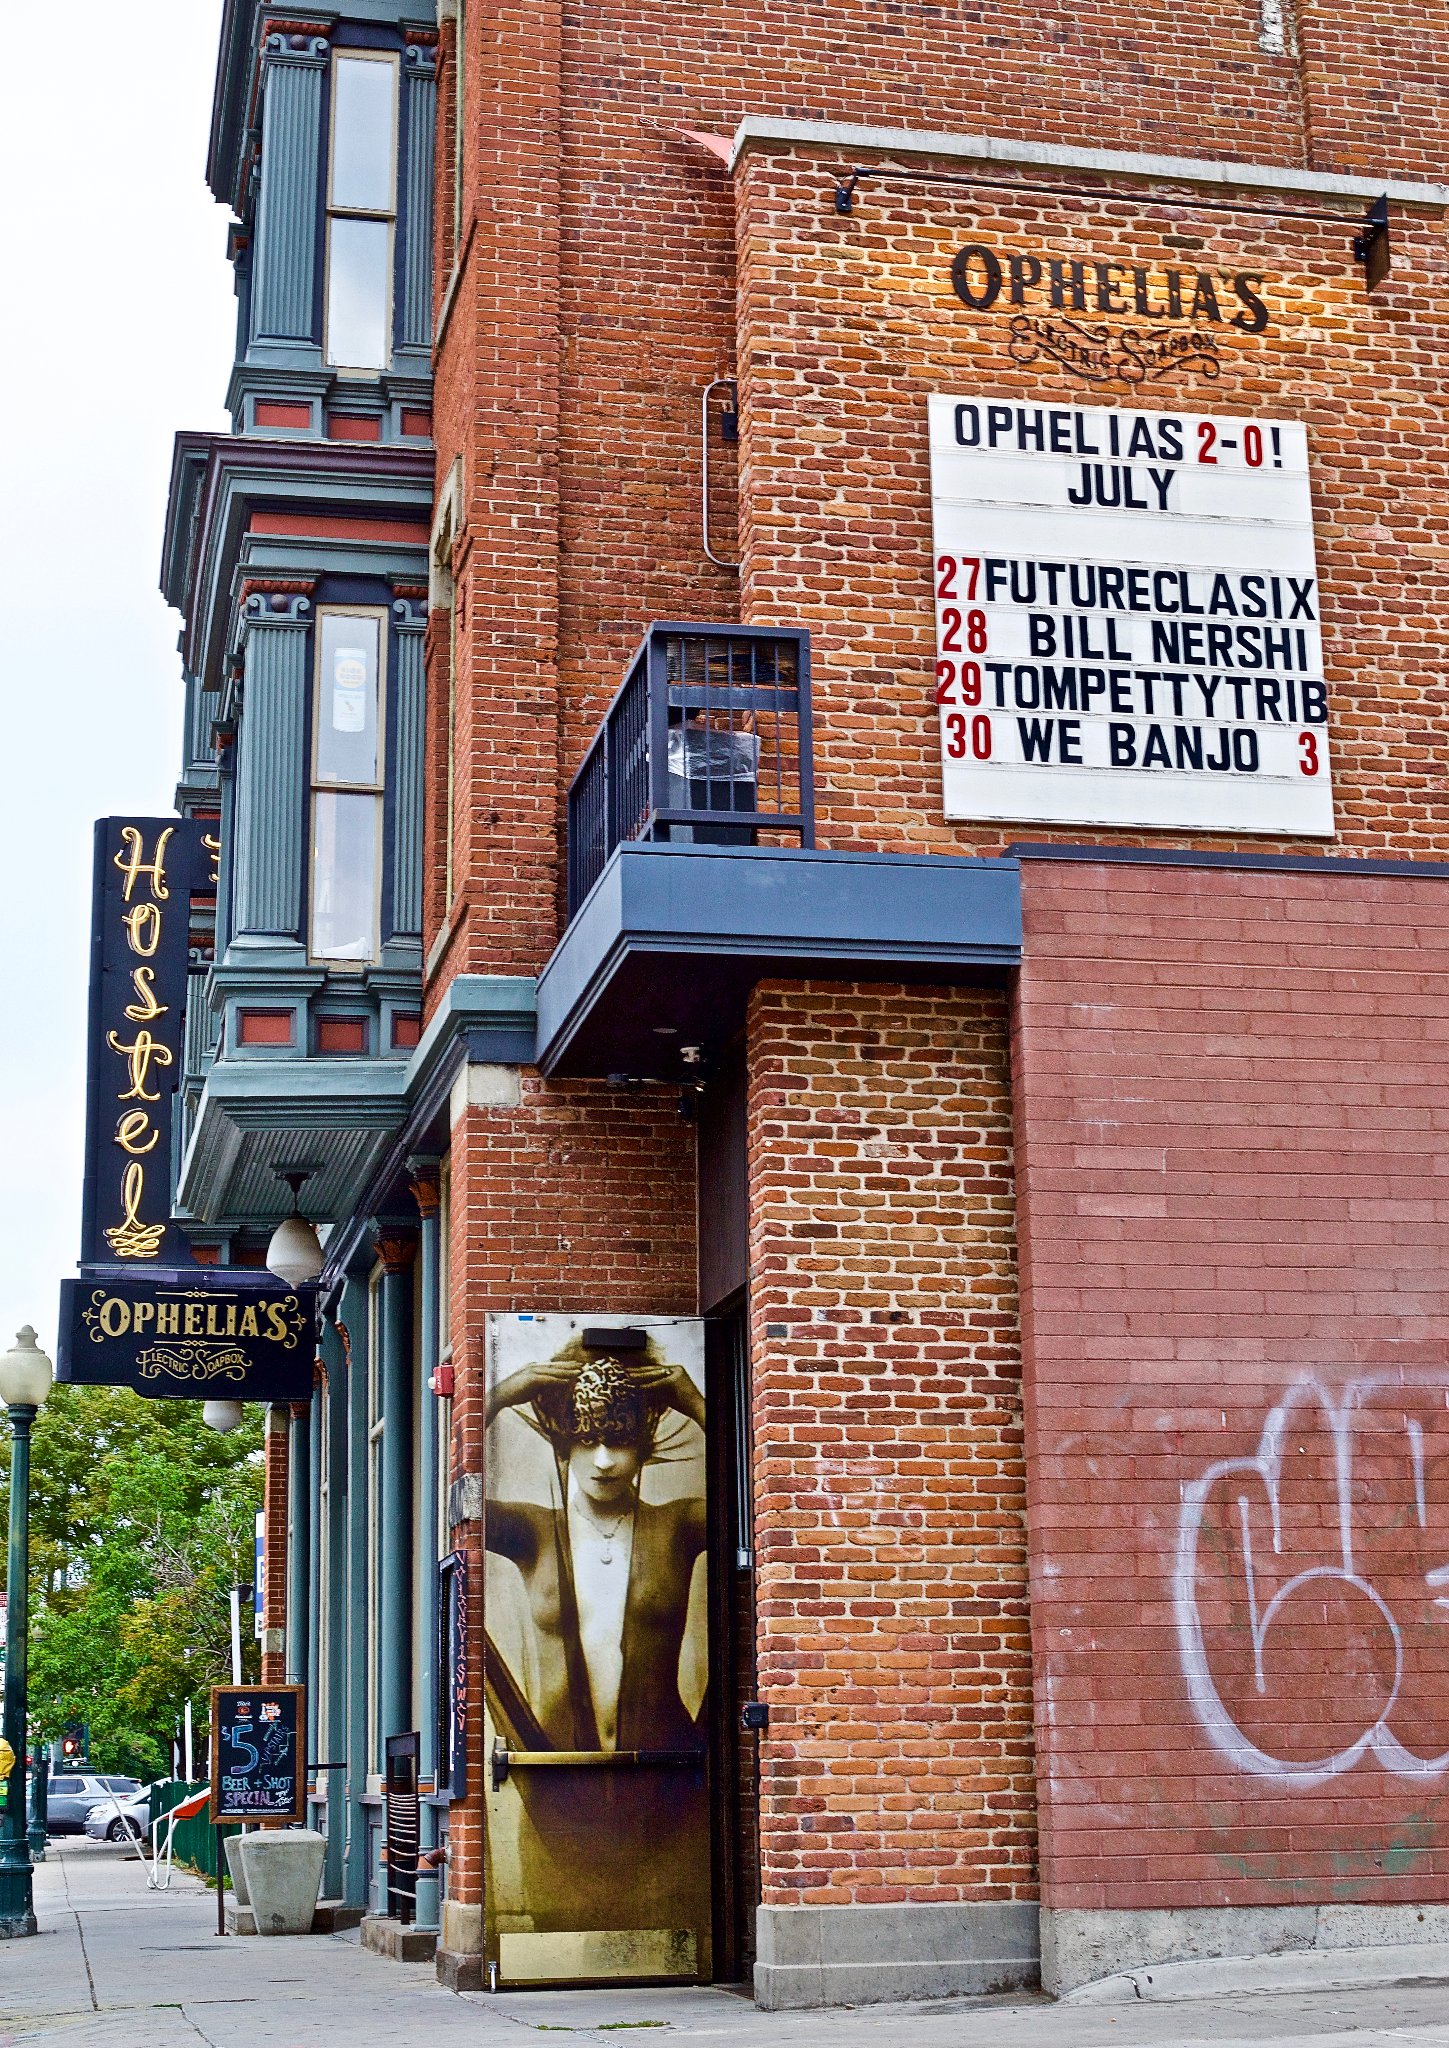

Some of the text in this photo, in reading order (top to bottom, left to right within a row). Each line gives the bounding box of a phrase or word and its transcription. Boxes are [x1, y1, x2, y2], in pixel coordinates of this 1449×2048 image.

[952, 244, 1269, 332] OPHELIA'S
[955, 403, 1282, 468] OPHELIAS 2-0!
[1068, 463, 1176, 511] JULY
[937, 555, 1316, 621] 27 FUTURECLASIX
[942, 607, 1308, 672] 28 BILL NERSHI
[936, 660, 1328, 725] 29 TOMPETTYTRIB
[946, 713, 1319, 776] 30 WE BANJO 3
[100, 1298, 288, 1341] OPHELIA'S
[136, 1348, 252, 1380] ELECTRIC SOAPBOX
[222, 1775, 251, 1791] BEER
[263, 1774, 293, 1790] SHOT
[224, 1790, 274, 1808] SPECIAL
